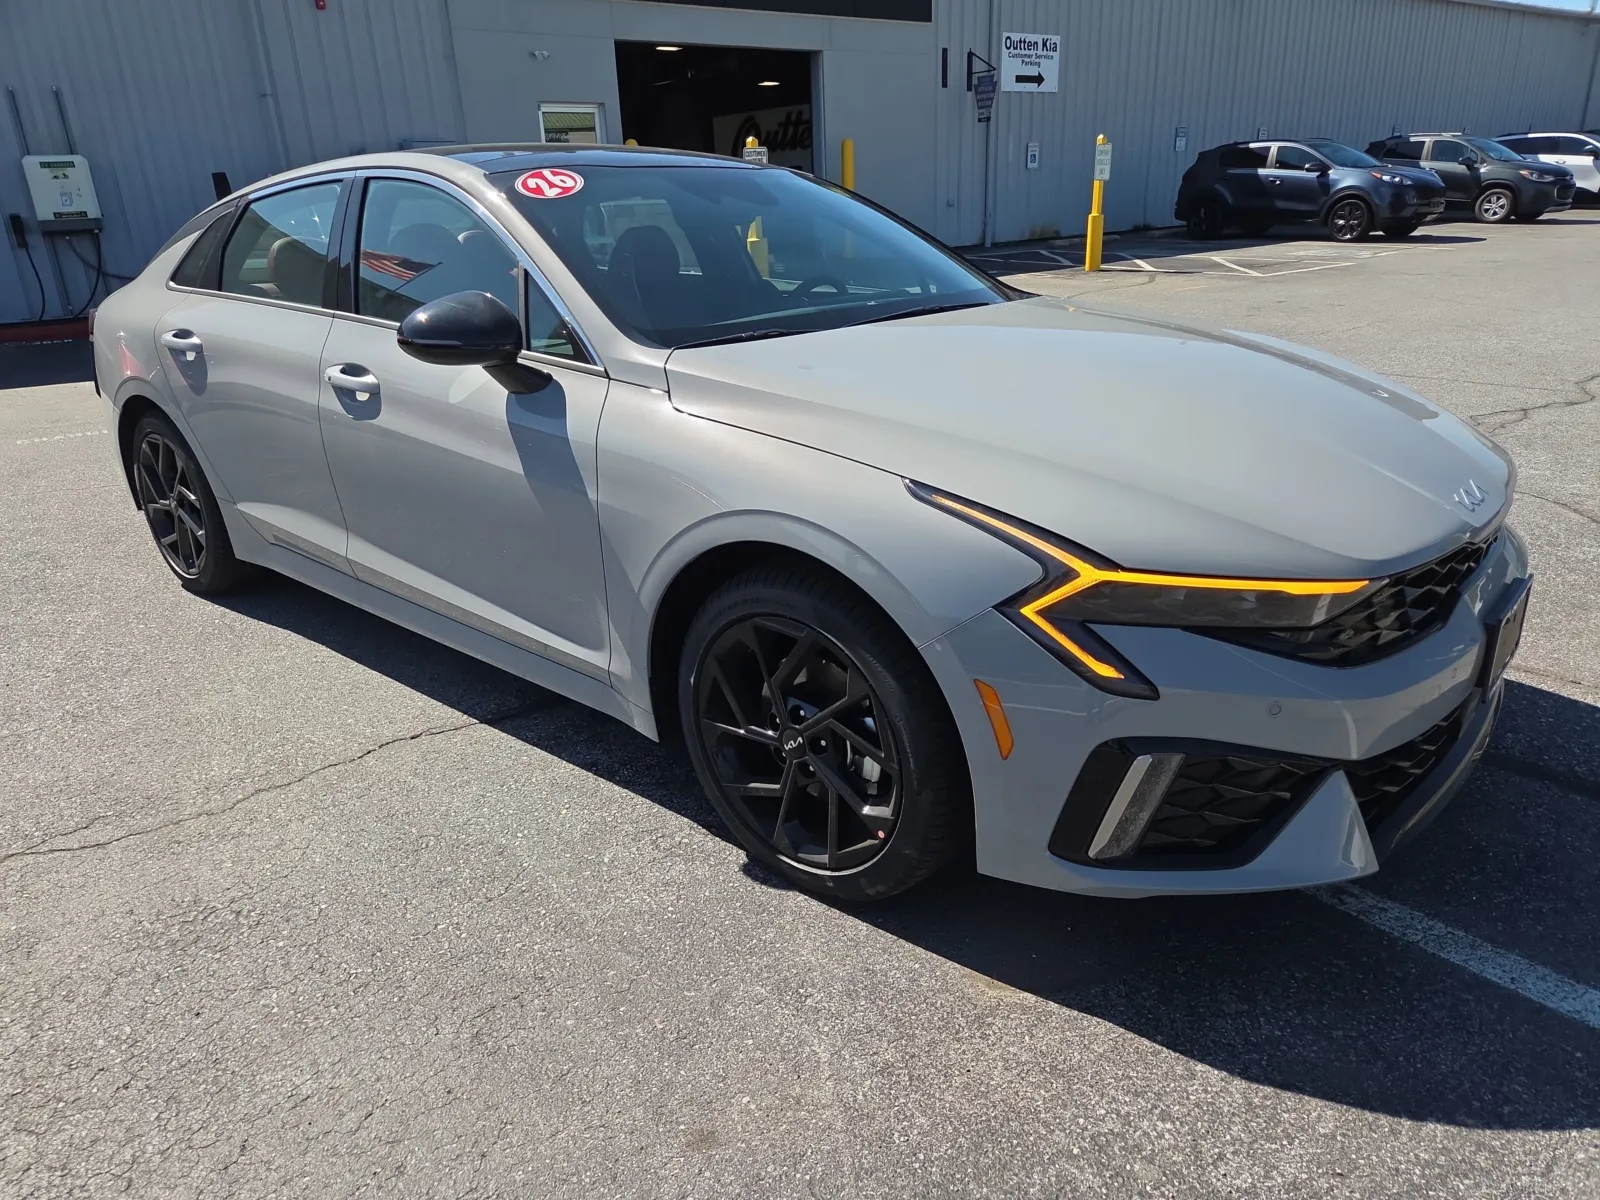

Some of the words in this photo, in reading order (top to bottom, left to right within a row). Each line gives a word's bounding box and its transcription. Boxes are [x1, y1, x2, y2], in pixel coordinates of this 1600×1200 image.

[1005, 35, 1039, 51] Outten
[1041, 37, 1058, 52] Kia
[1008, 51, 1034, 59] Customer
[1034, 52, 1054, 60] Service
[1021, 59, 1041, 69] Parking
[745, 150, 766, 158] CUSTOMER
[526, 170, 576, 197] 26
